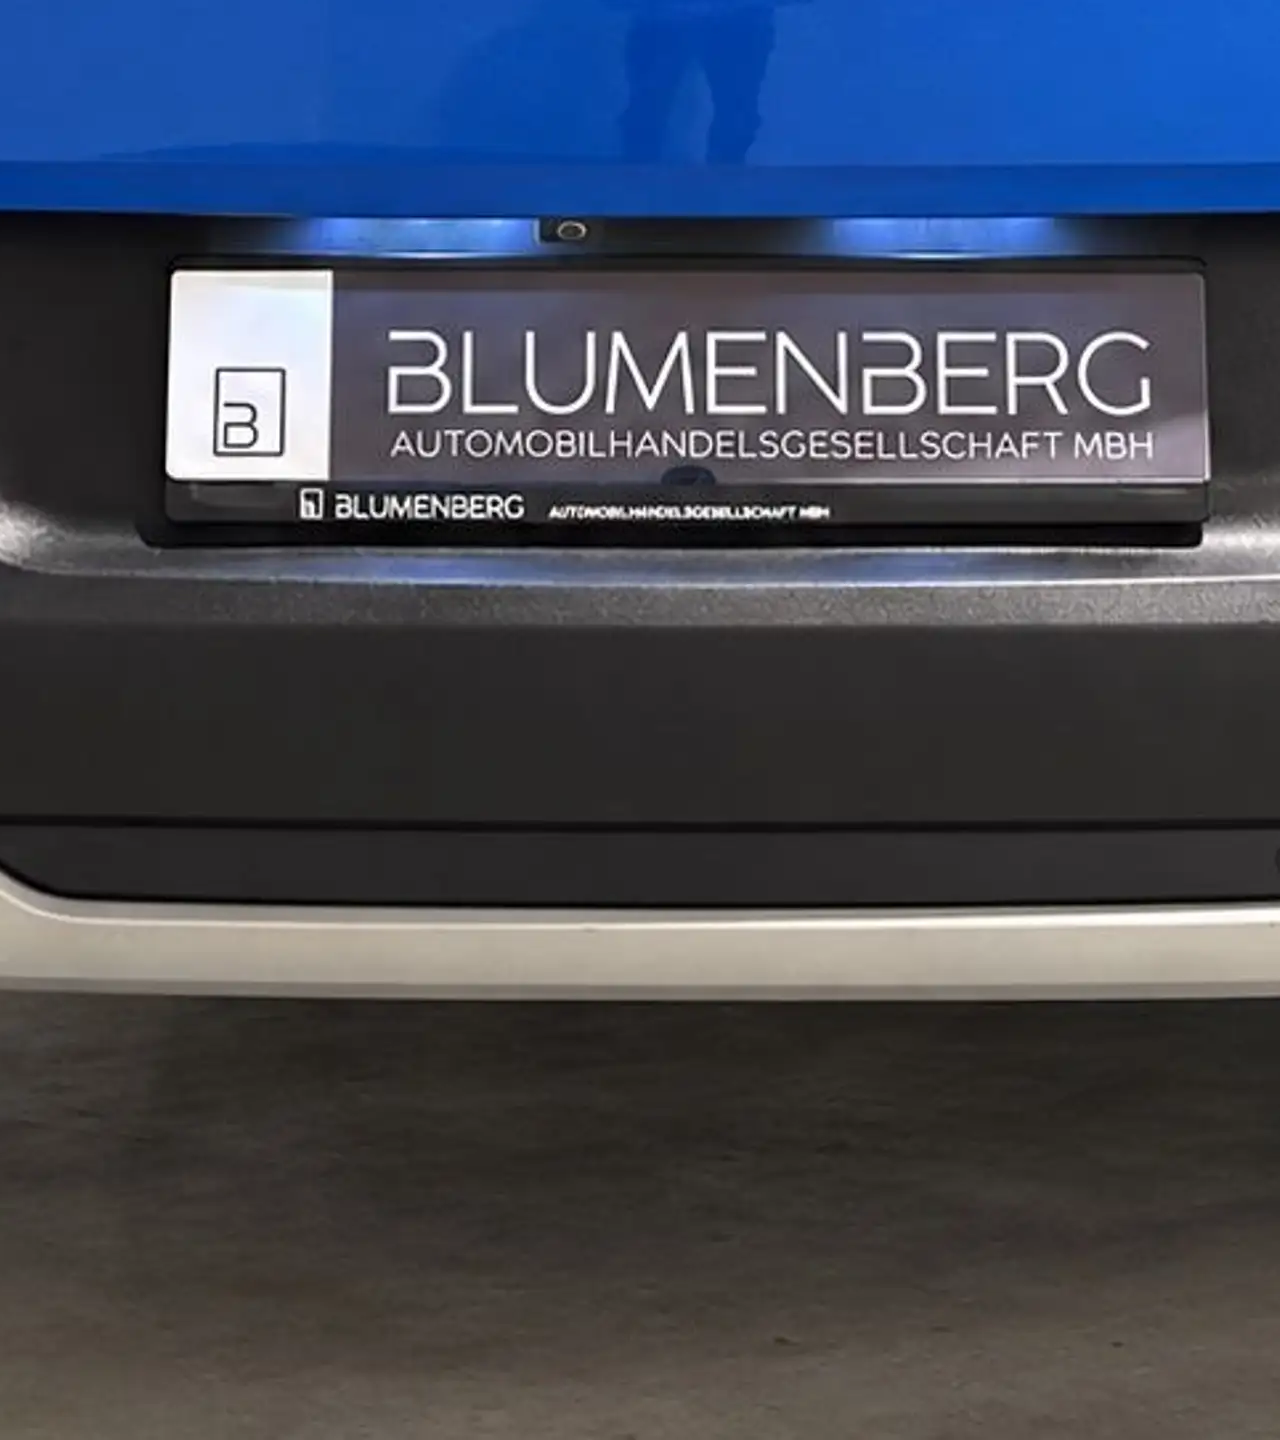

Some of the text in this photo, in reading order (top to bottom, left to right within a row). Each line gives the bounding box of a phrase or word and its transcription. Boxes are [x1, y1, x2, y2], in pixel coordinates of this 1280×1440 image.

[387, 331, 1151, 416] BLUMENBERG
[390, 428, 1154, 460] AUTOMOBILHANDELSGESELLSCHAFT MBH
[334, 494, 525, 519] BLUMENBERG
